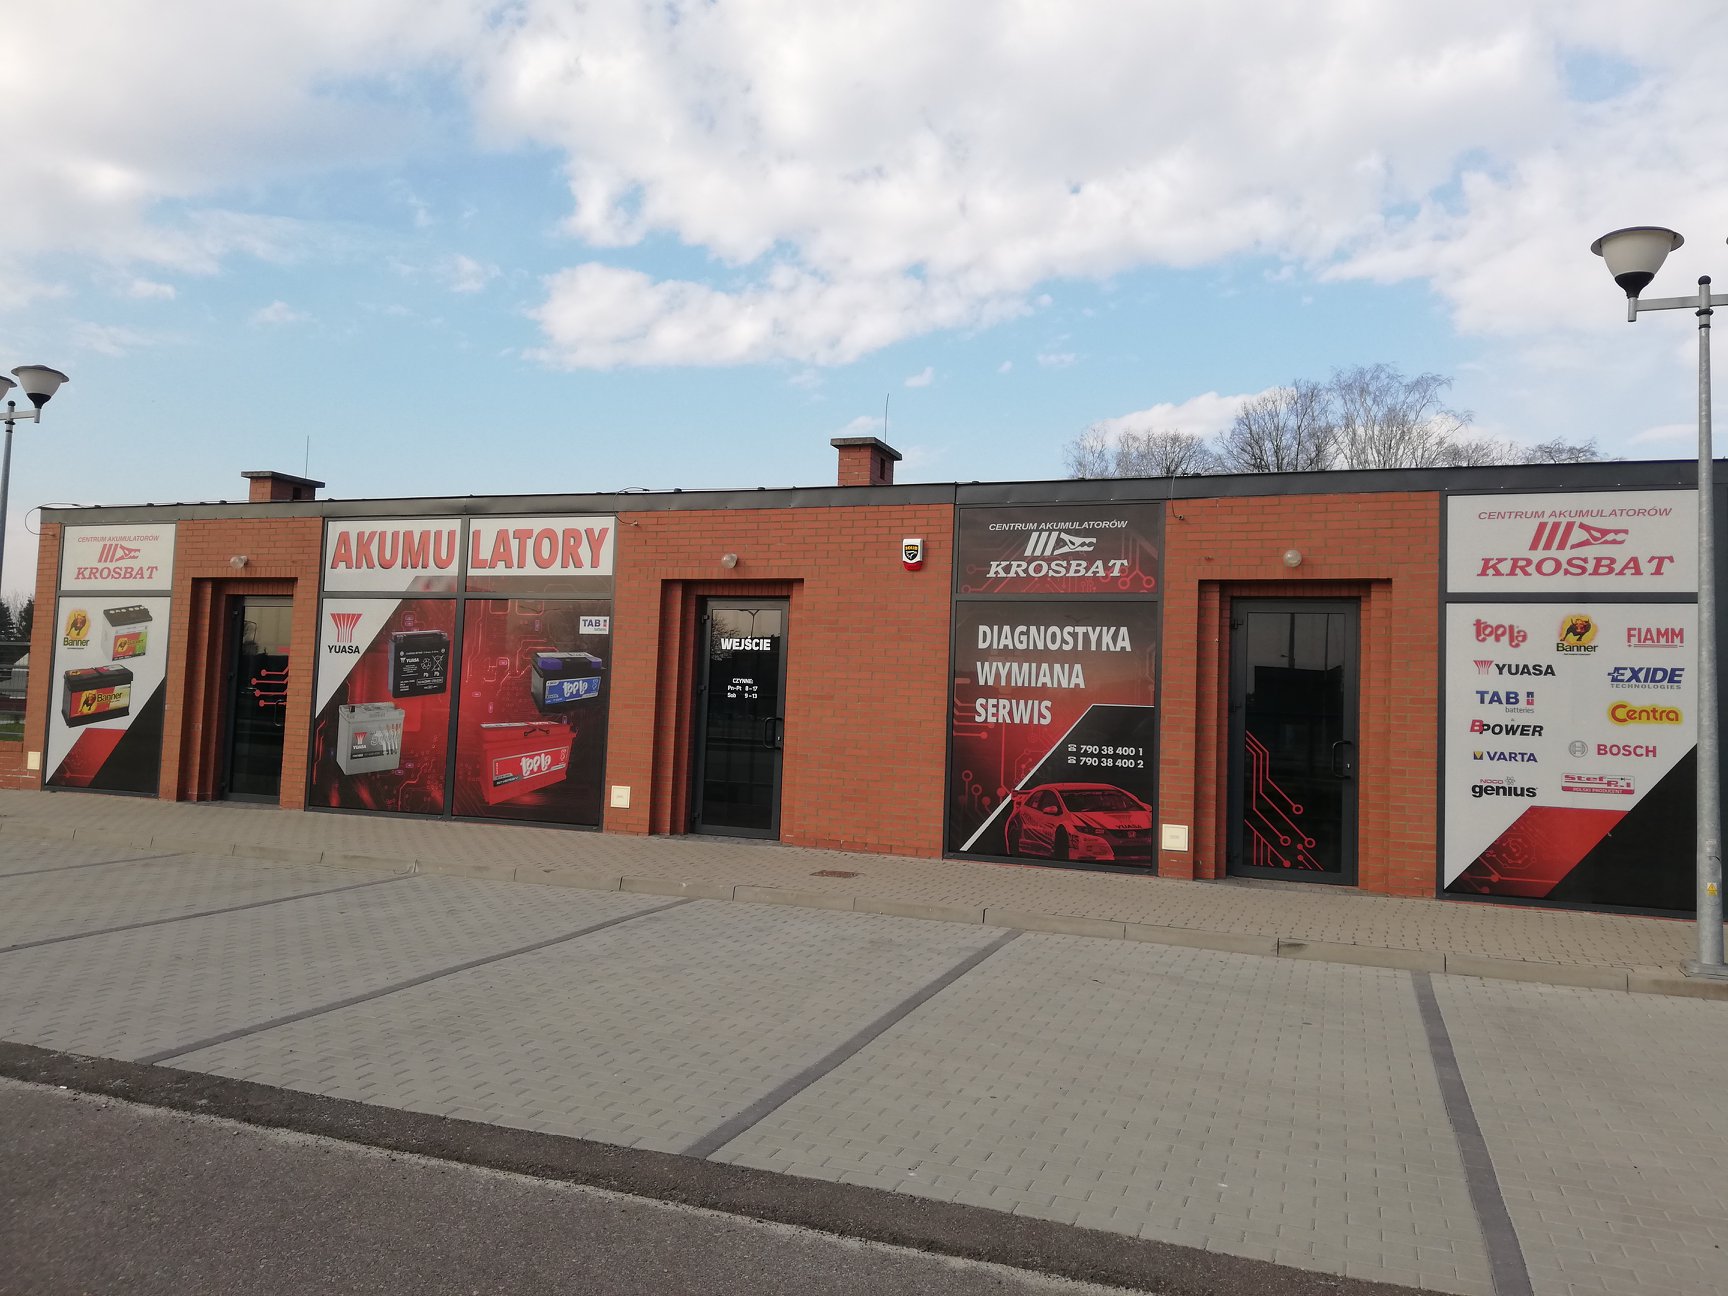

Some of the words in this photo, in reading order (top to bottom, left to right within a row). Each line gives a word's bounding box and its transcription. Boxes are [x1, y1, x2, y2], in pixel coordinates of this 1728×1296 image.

[1478, 509, 1545, 520] CENTRUM
[1548, 507, 1673, 519] AKUMULATORÓW
[988, 522, 1037, 531] CENTRUM
[1038, 519, 1128, 530] AKUMULATORÓW
[330, 529, 456, 570] AKUMU
[470, 527, 609, 569] LATORY
[74, 565, 159, 580] KROSBAT
[986, 559, 1129, 578] KROSBAT
[1476, 555, 1675, 577] KROSBAT
[581, 619, 601, 627] TAB
[63, 637, 90, 647] Banner
[720, 635, 771, 651] WEJŚCIE
[977, 625, 1132, 651] DIAGNOSTYKA
[1626, 627, 1685, 645] FIAMM
[327, 645, 360, 654] YUASA
[1556, 642, 1599, 653] Banner
[976, 661, 1086, 689] WYMIANA
[1494, 664, 1556, 677] YUASA
[1607, 667, 1685, 684] EXIDE
[96, 692, 123, 702] Banner
[1476, 690, 1520, 705] TAB
[974, 697, 1052, 725] SERWIS
[1505, 706, 1535, 714] batteries
[1610, 703, 1680, 723] Centra
[1080, 745, 1099, 754] 790
[1101, 746, 1114, 754] 38
[1115, 747, 1136, 755] 400
[1138, 748, 1143, 756] 1
[1486, 751, 1538, 763] VARTA
[1597, 743, 1657, 758] BOSCH
[1080, 757, 1099, 766] 790
[1100, 758, 1113, 767] 38
[1115, 759, 1135, 768] 400
[1137, 760, 1144, 768] 2
[1471, 784, 1538, 798] genius
